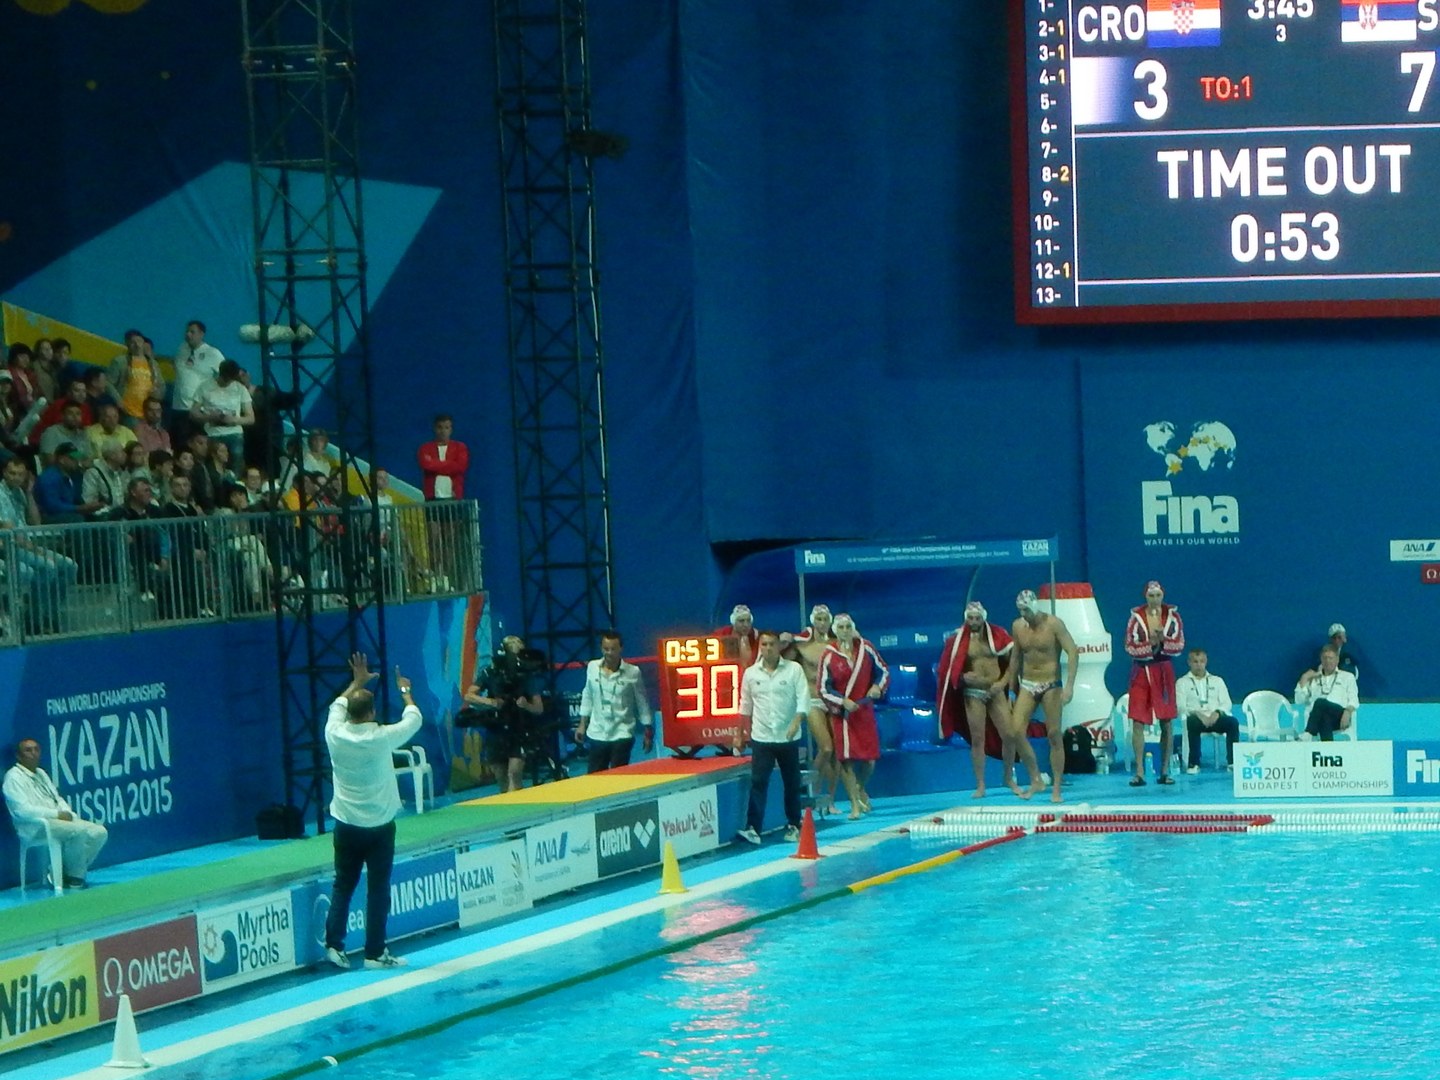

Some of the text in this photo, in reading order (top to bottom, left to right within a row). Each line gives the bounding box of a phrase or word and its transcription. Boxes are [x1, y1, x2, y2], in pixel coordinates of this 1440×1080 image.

[1077, 4, 1146, 43] CRO
[1247, 0, 1315, 20] 3:45
[1275, 23, 1287, 43] 3
[1133, 59, 1169, 121] 3
[1199, 75, 1252, 100] TO:1
[1400, 51, 1436, 113] 7
[1157, 144, 1412, 200] TIME OUT
[1230, 212, 1340, 263] 0:53
[1141, 480, 1240, 535] Fina
[1144, 537, 1240, 547] WATER IS OUR WORLD
[1403, 543, 1425, 553] ANA
[1077, 643, 1110, 654] akult
[46, 682, 166, 716] FINA WORLD CHAMPIONSHIPS
[676, 664, 739, 718] 30
[48, 705, 171, 789] KAZAN
[1312, 751, 1343, 768] Fina
[1242, 781, 1299, 791] BUDAPEST
[1264, 766, 1296, 781] 2017
[1312, 771, 1347, 780] WORLD
[1312, 780, 1390, 790] CHAMPIONSHIPS
[127, 775, 173, 820] 2015
[600, 825, 632, 858] arena
[662, 813, 698, 838] Yakult
[534, 837, 559, 867] ANA
[390, 868, 457, 916] AMSUNG
[459, 866, 495, 892] KAZAN
[237, 906, 290, 942] Myrtha
[127, 945, 196, 991] OMEGA
[239, 938, 280, 973] Pools
[0, 972, 88, 1041] Nikon
